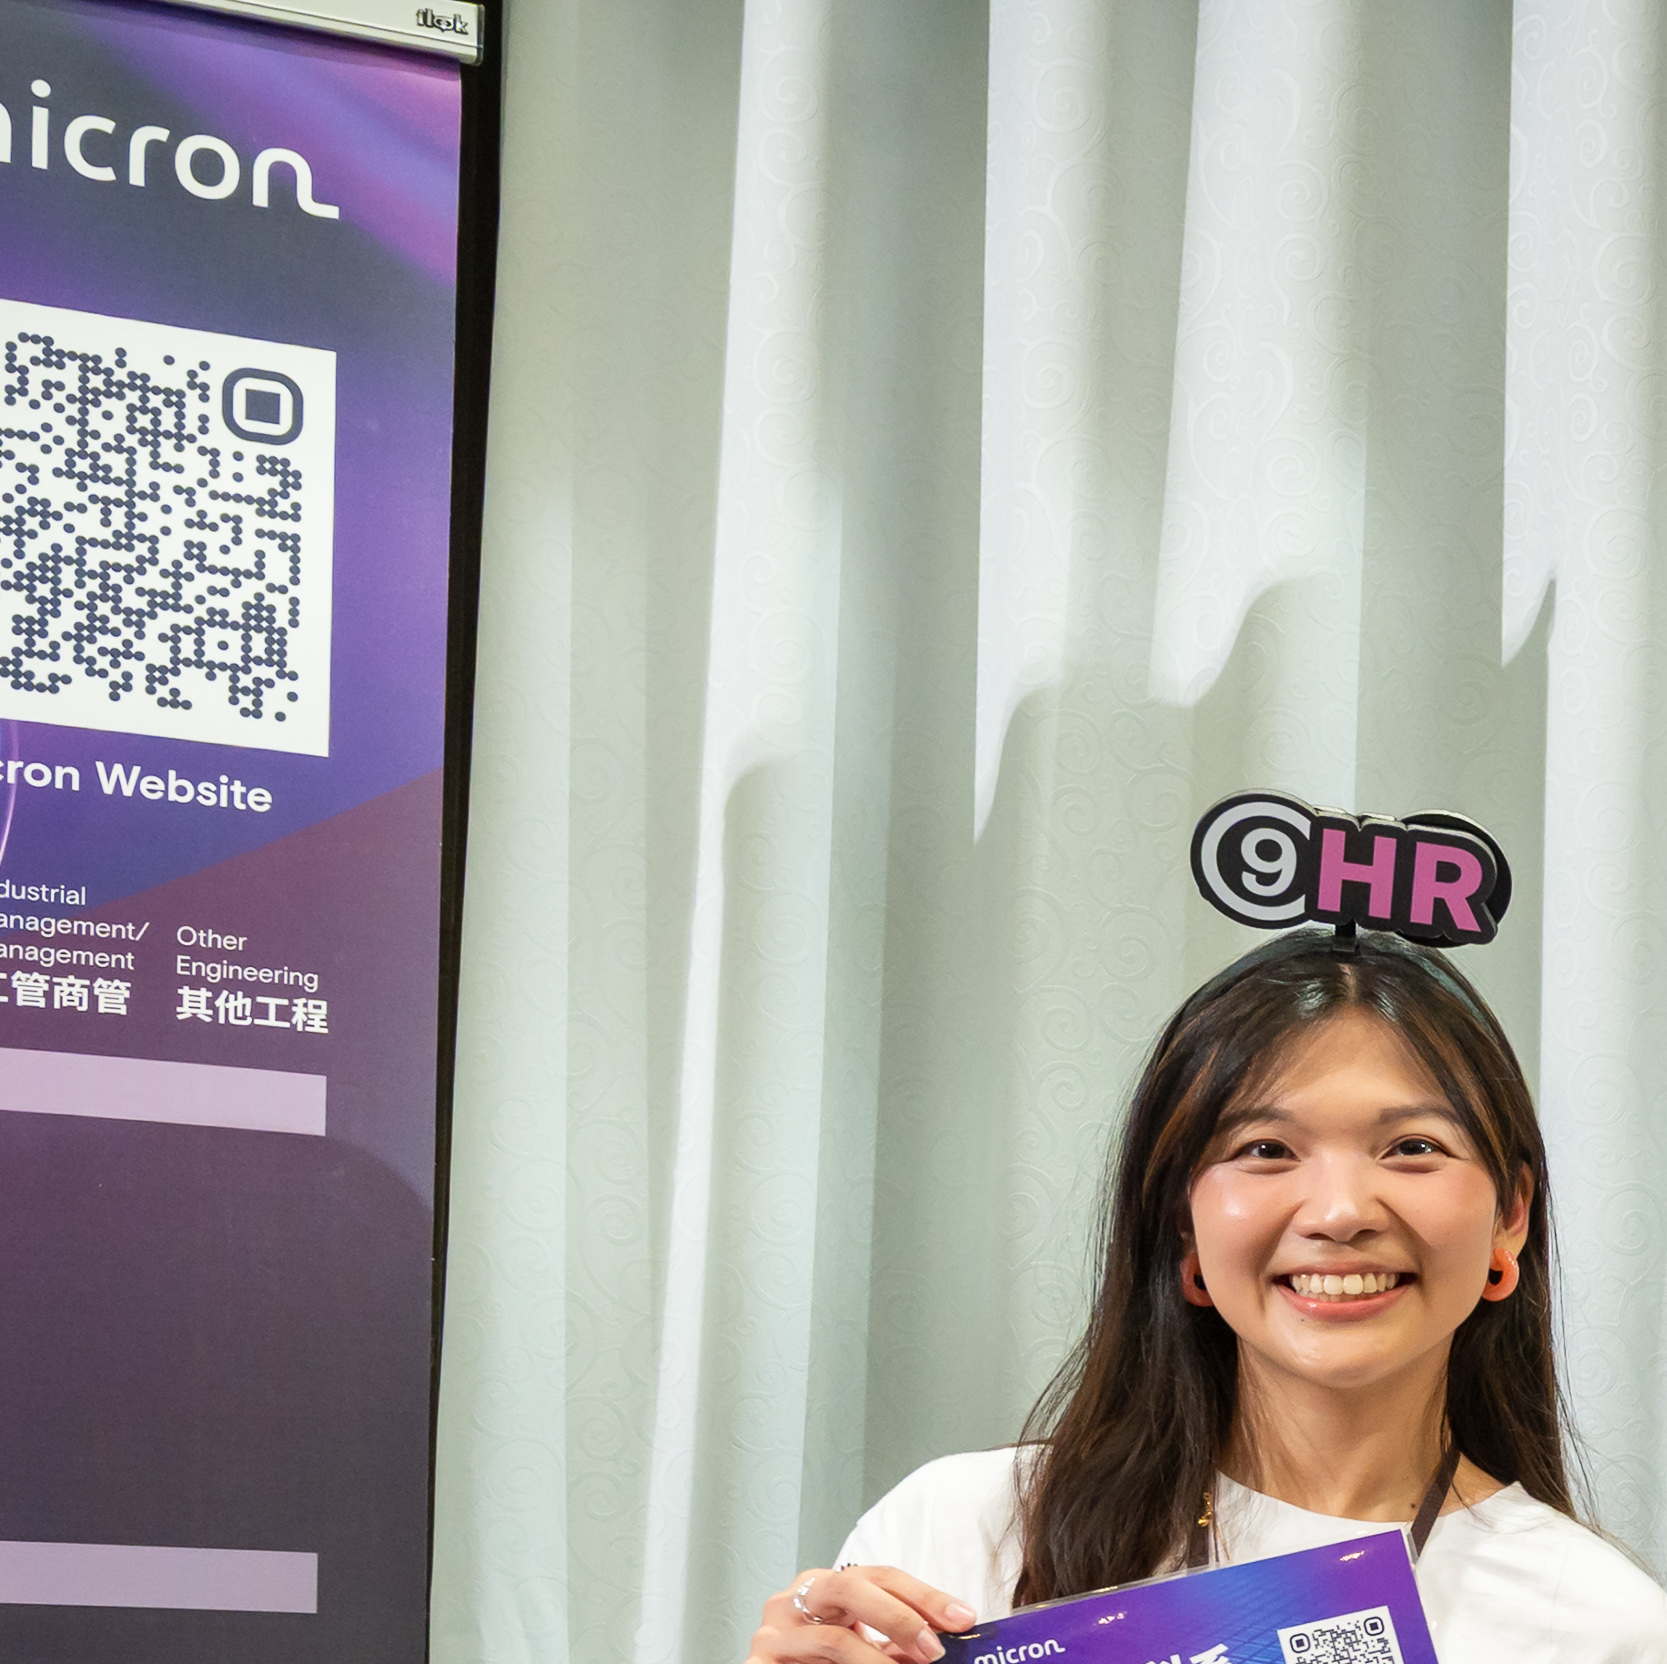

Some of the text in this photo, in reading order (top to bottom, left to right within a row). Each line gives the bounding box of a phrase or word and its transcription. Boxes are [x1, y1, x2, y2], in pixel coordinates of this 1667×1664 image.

[95, 761, 273, 813] Website
[176, 925, 248, 951] Other
[176, 955, 319, 992] Engineering
[175, 986, 330, 1035] 其他工程
